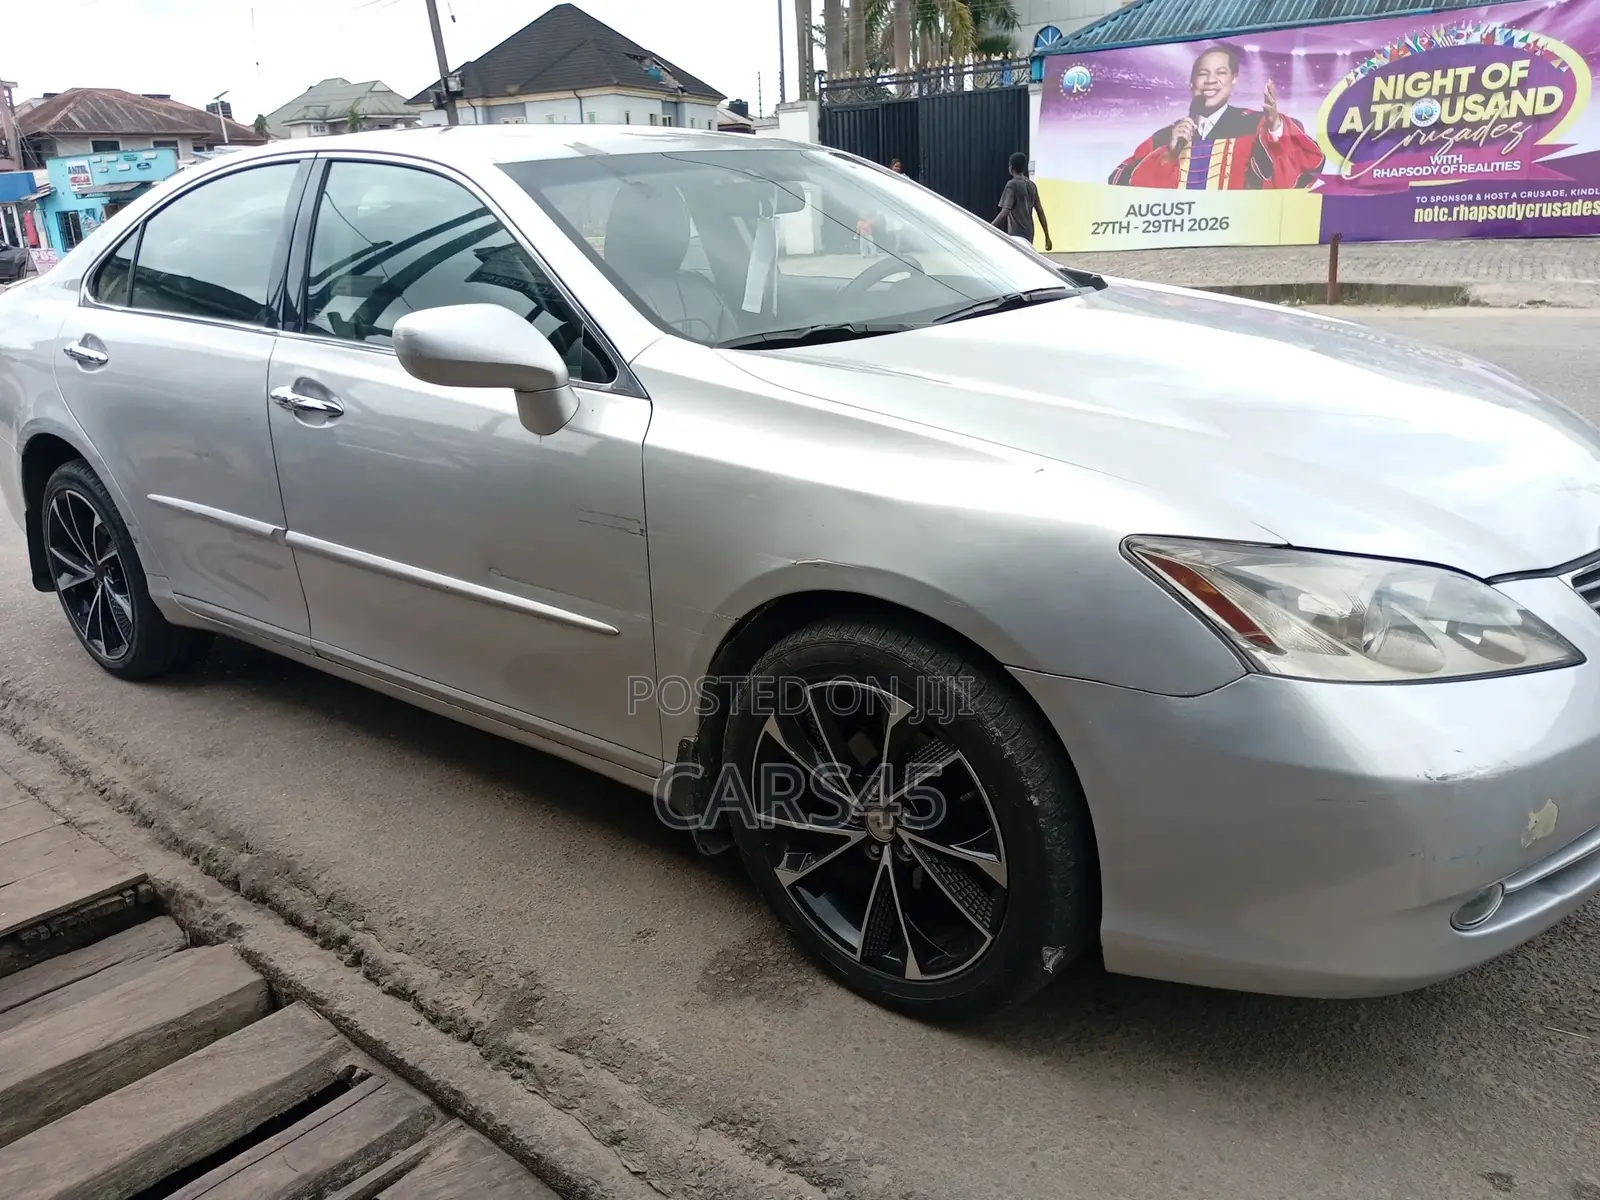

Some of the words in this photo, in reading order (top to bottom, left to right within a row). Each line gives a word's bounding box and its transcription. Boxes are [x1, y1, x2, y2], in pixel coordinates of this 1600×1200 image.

[1372, 65, 1476, 101] NIGHT
[1481, 59, 1530, 91] OF
[1338, 106, 1363, 134] A
[1370, 86, 1564, 131] THOUSAND
[1341, 100, 1532, 180] Crusades
[1372, 164, 1439, 179] RHAPSODY
[1440, 164, 1459, 175] OF
[1459, 160, 1521, 174] REALITIES
[1430, 154, 1463, 166] WITH
[1416, 196, 1428, 204] TO
[1430, 193, 1473, 203] SPONSOR
[1475, 193, 1482, 201] &
[1484, 191, 1509, 201] HOST
[1511, 191, 1518, 199] A
[1520, 188, 1568, 198] CRUSADE,
[1125, 201, 1196, 218] AUGUST
[1414, 198, 1600, 223] notc.rhapsodycrusades
[1091, 220, 1130, 235] 27TH
[1141, 218, 1184, 234] 29TH
[1187, 216, 1230, 232] 2026
